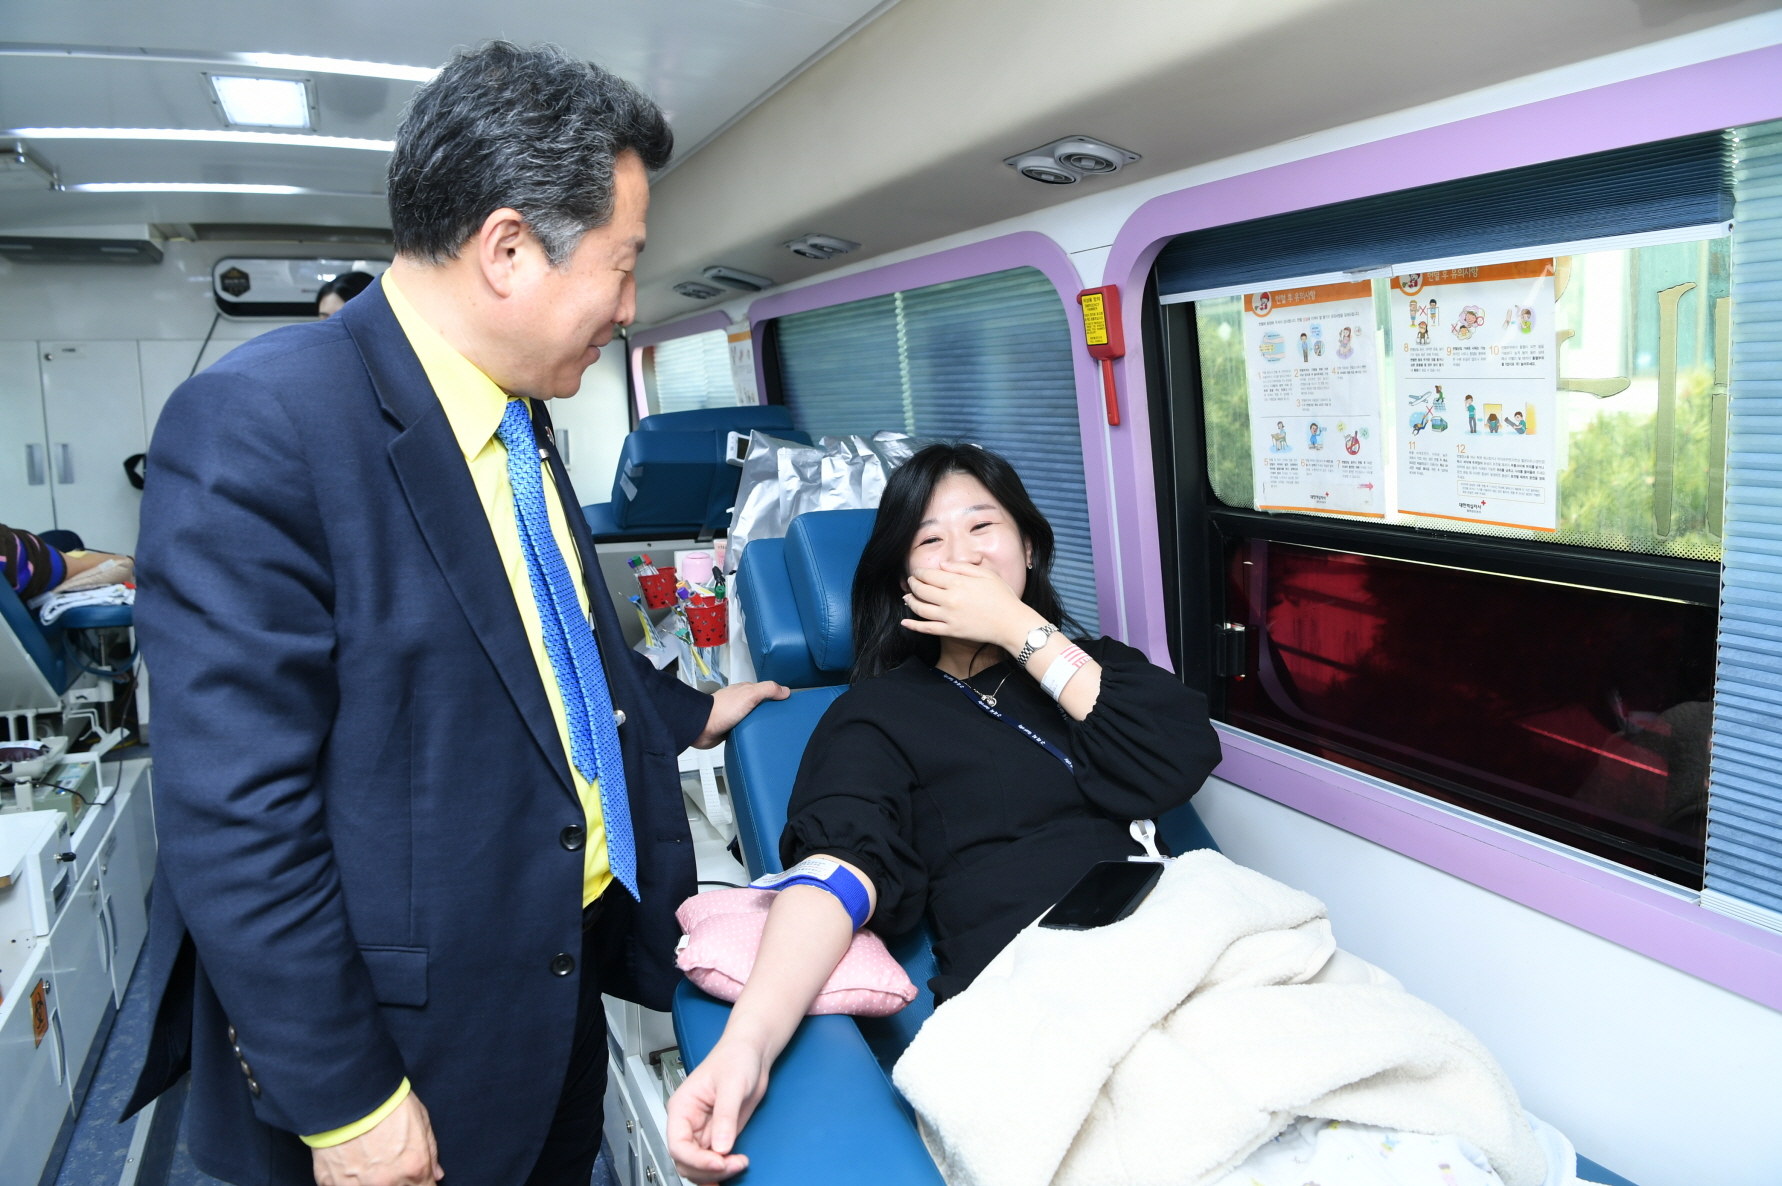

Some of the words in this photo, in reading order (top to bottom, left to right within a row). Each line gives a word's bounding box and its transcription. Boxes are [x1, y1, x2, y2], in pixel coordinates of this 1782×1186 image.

[1442, 270, 1448, 278] 후
[1275, 294, 1286, 304] 헌혈
[1288, 293, 1294, 302] 후
[1294, 290, 1316, 302] 유의사항
[1404, 343, 1408, 352] 8
[1446, 346, 1452, 356] 9
[1489, 346, 1500, 355] 10
[1294, 368, 1298, 378] 2
[1296, 399, 1300, 407] 3
[1408, 441, 1416, 450] 11
[1456, 444, 1466, 454] 12
[1264, 458, 1268, 466] 5
[1301, 458, 1305, 466] 6
[1337, 460, 1340, 468] 7
